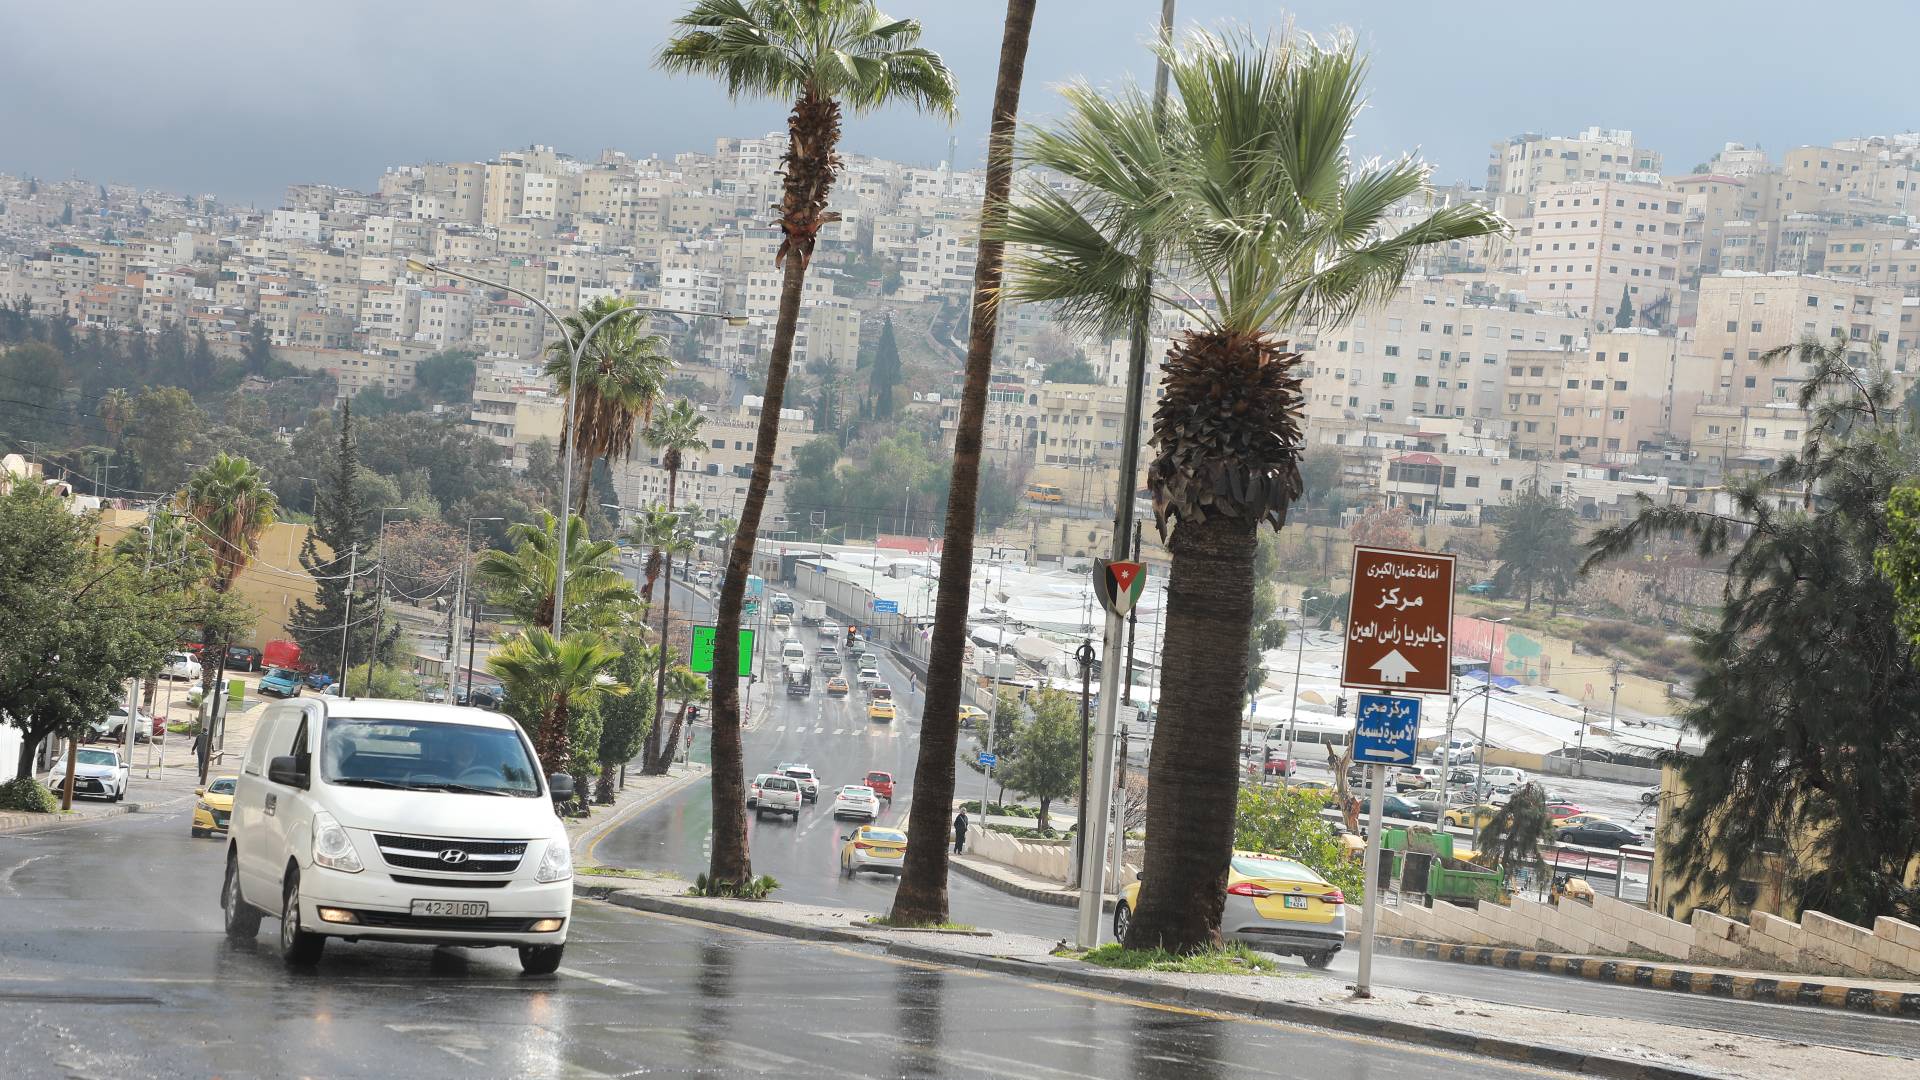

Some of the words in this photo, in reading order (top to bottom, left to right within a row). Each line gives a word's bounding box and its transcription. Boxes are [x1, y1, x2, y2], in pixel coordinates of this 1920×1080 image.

[1367, 562, 1395, 579] الكبرى
[1395, 563, 1417, 579] عمان
[1417, 563, 1440, 579] أمانة
[1374, 587, 1424, 611] مركز
[1350, 620, 1378, 644] العين
[1378, 617, 1401, 644] رأس
[1404, 623, 1446, 649] جاليريا
[1364, 702, 1388, 719] صحي
[1387, 700, 1410, 718] مركز
[1357, 717, 1384, 744] بسمة
[1384, 718, 1416, 745] الأميرة
